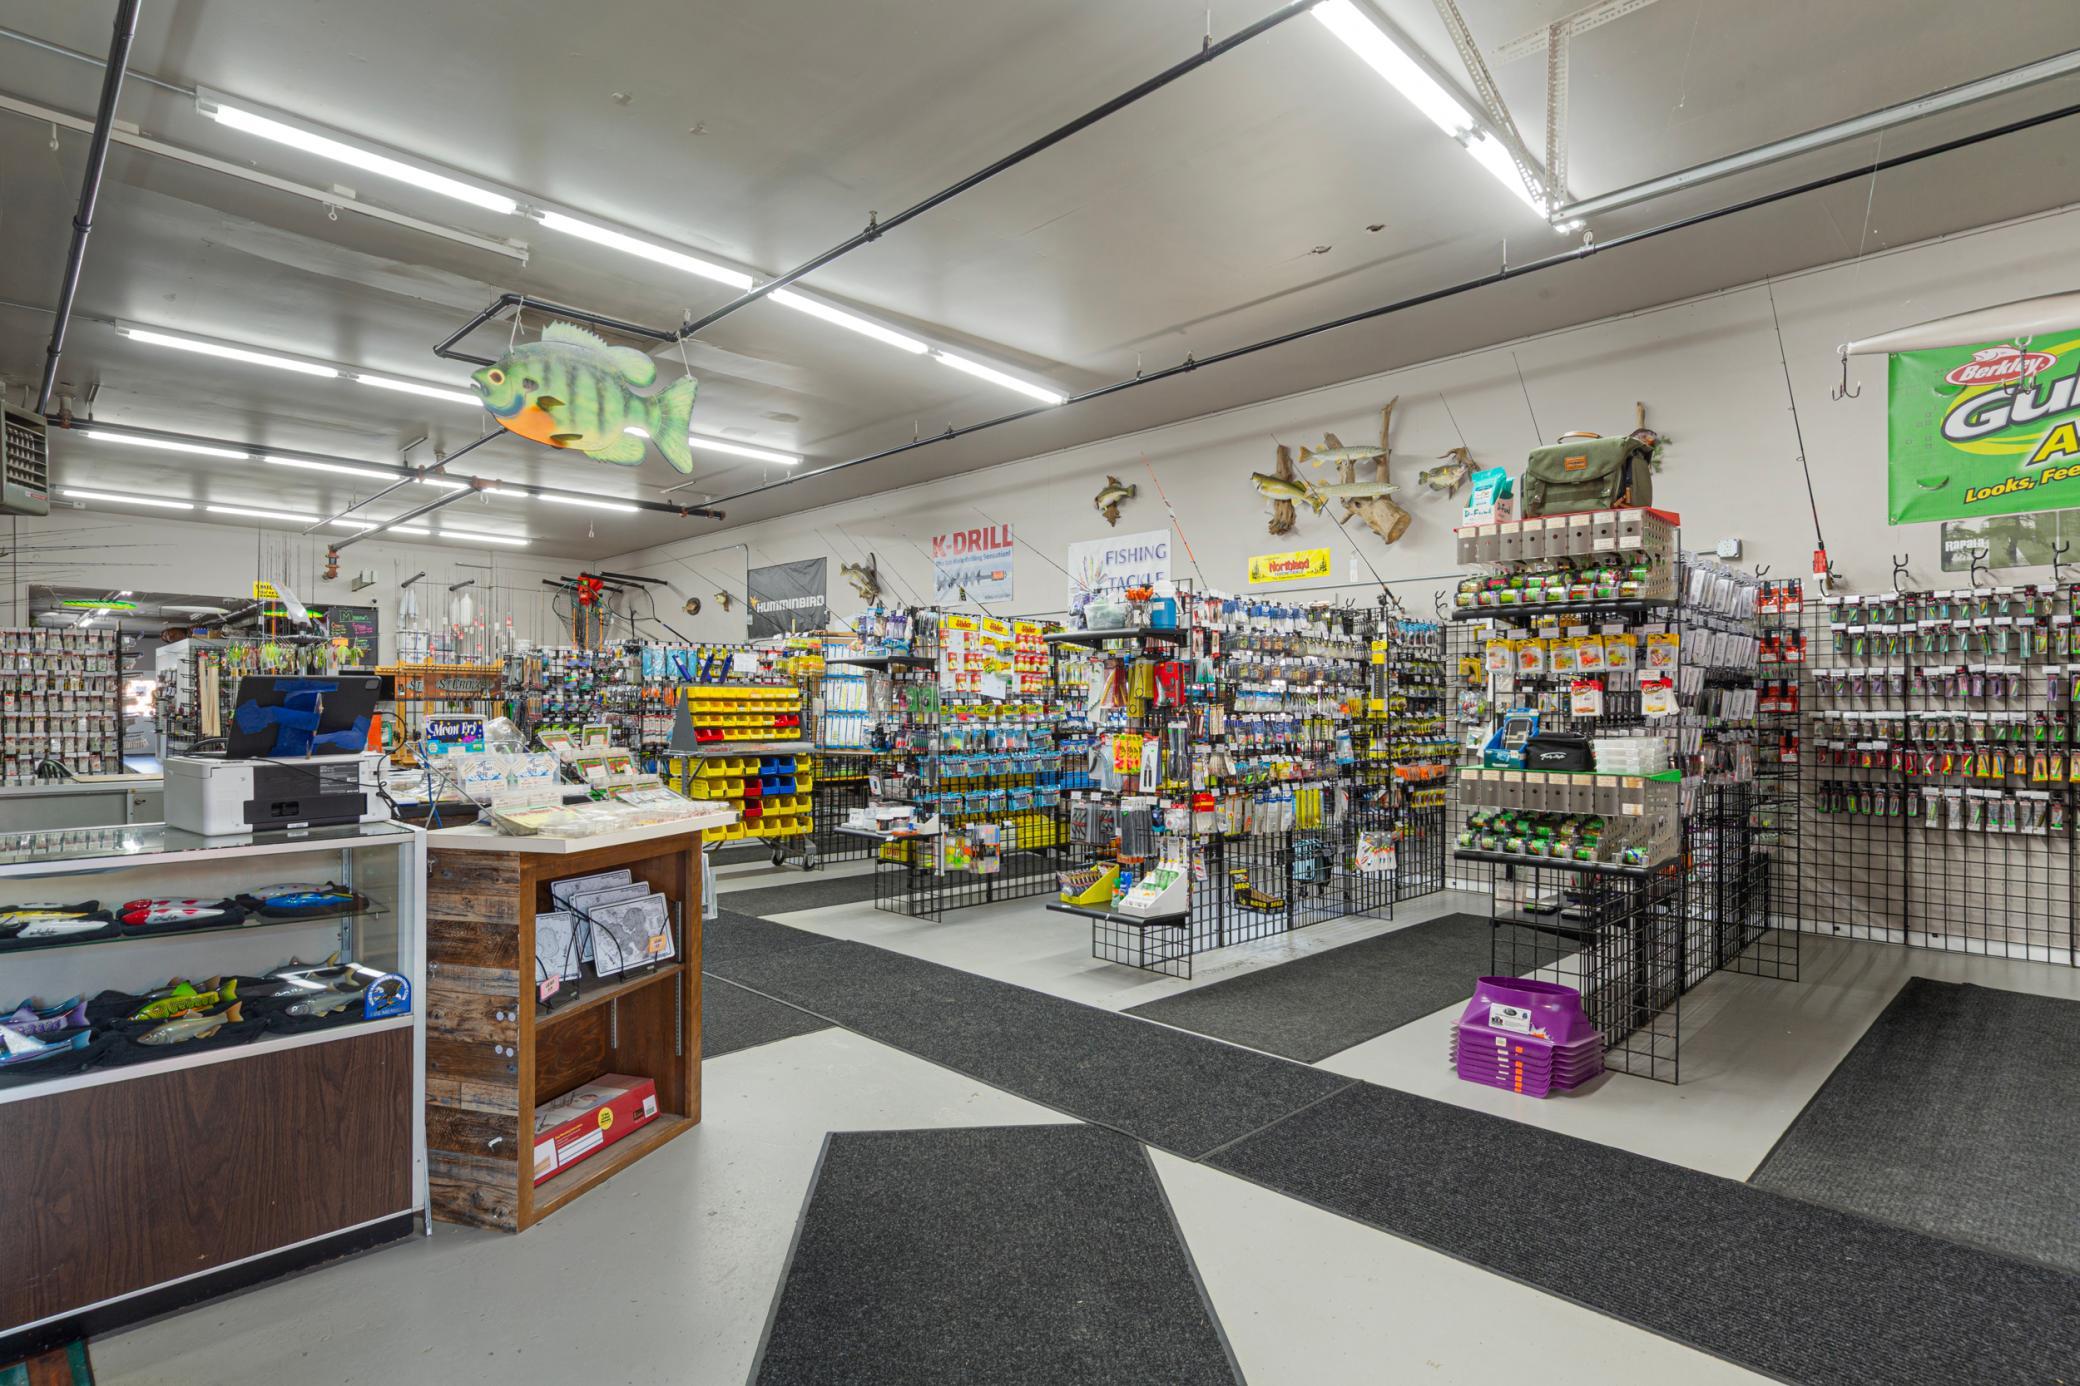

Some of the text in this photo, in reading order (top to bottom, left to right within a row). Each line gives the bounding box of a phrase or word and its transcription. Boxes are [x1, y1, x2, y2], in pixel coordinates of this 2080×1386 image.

[1959, 356, 2042, 383] Berkley
[1963, 475, 2037, 504] Looks,
[931, 523, 1013, 558] K-DRILL
[1105, 543, 1167, 565] FISHING
[1269, 558, 1310, 573] Northland
[756, 595, 825, 613] HUMMINBIRD
[434, 720, 478, 737] Moon Fry
